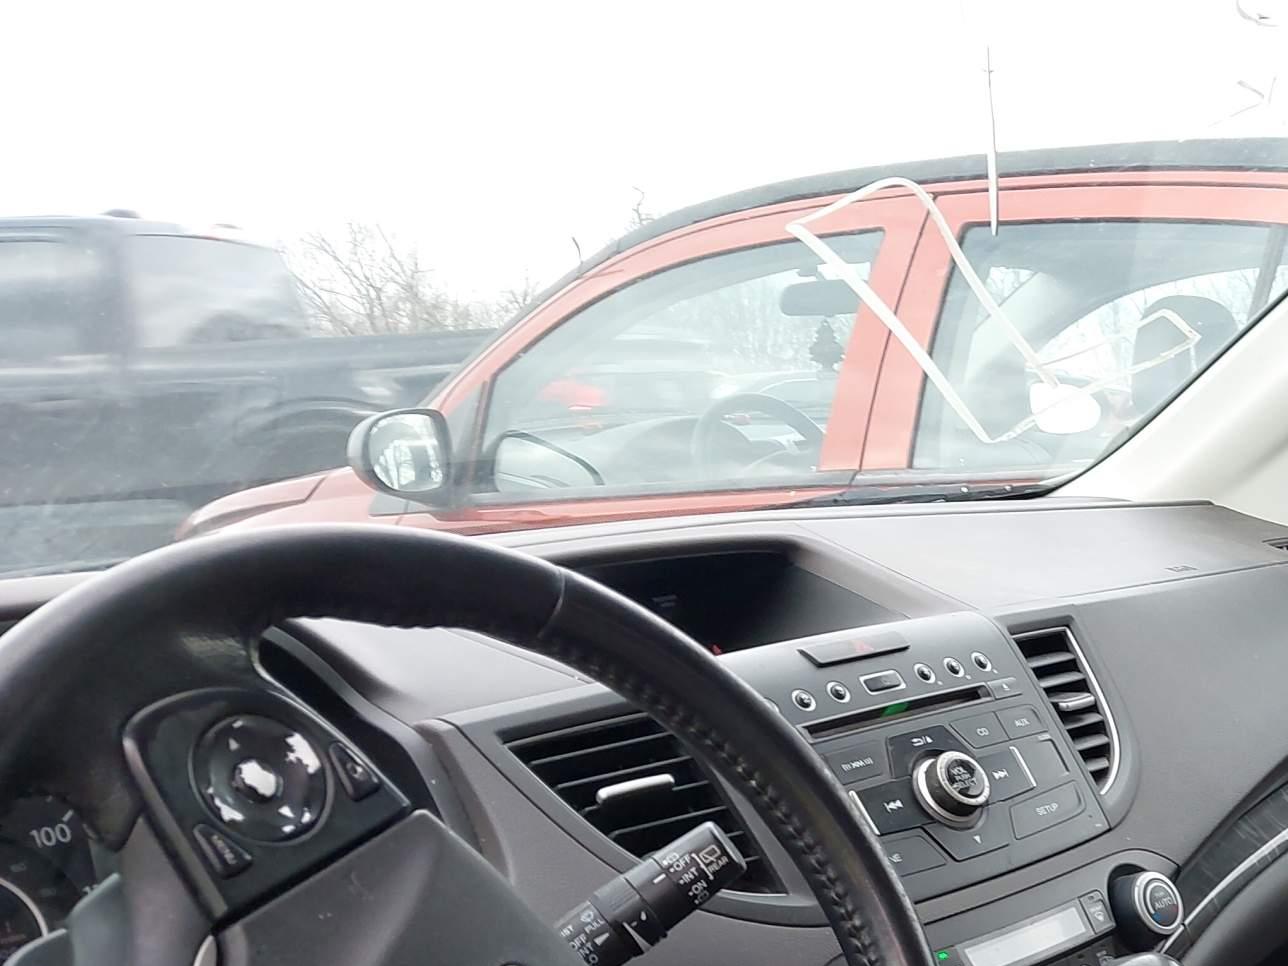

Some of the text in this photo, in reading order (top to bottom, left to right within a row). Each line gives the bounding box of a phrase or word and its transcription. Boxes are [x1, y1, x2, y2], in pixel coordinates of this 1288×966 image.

[976, 727, 990, 737] CD
[1035, 802, 1058, 817] SETUP
[30, 823, 72, 848] 100
[673, 854, 691, 871] OFF
[707, 855, 729, 873] REAR
[681, 866, 699, 884] INT
[692, 880, 708, 894] ON
[1154, 896, 1173, 910] AUTO
[584, 919, 606, 934] PULL
